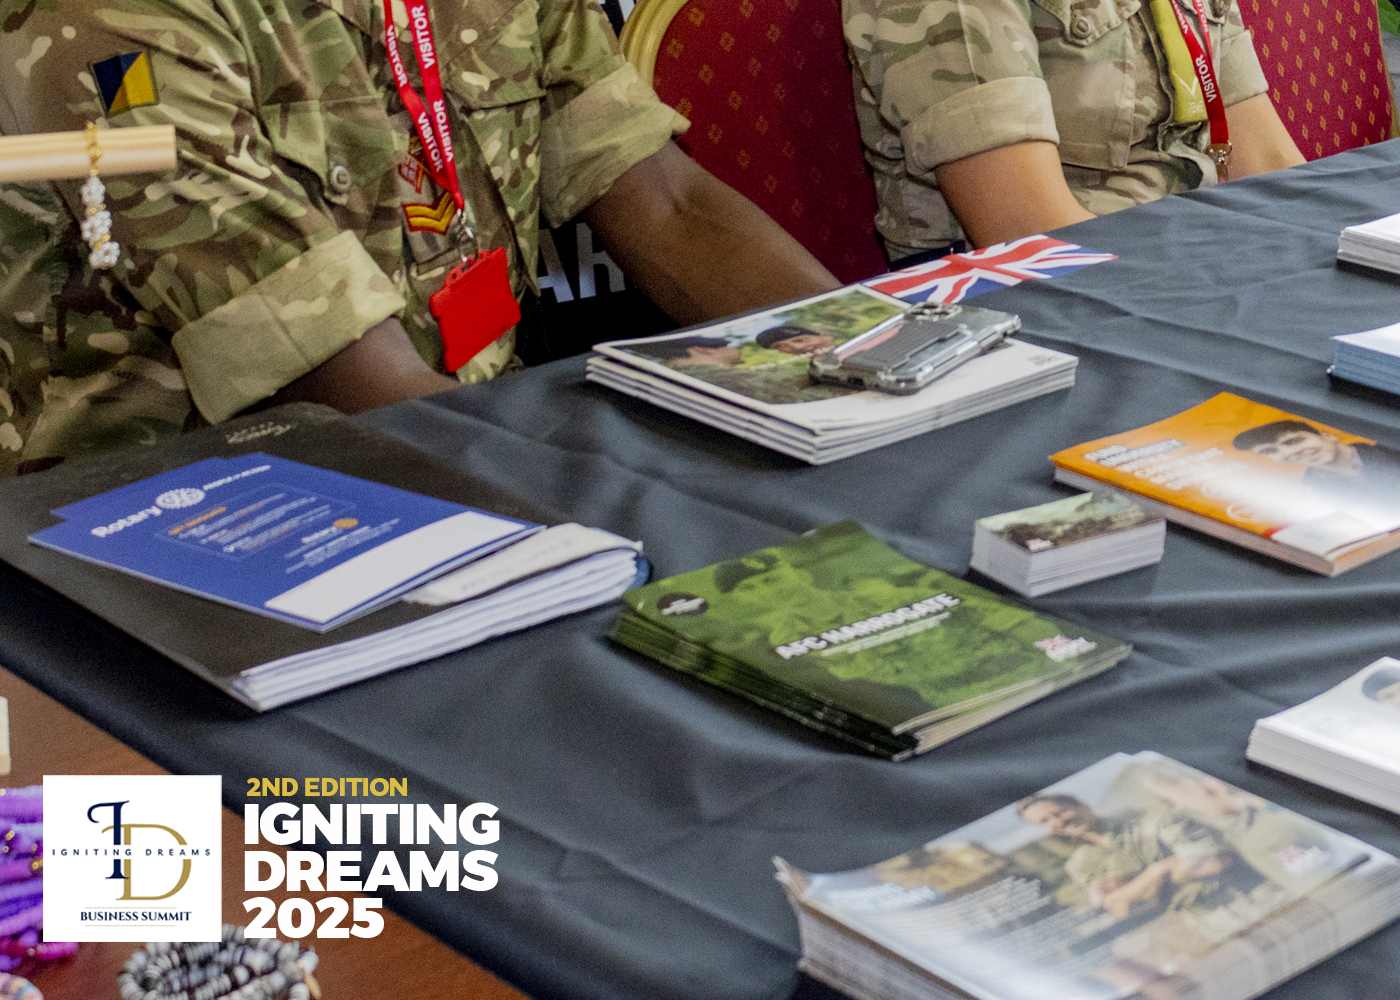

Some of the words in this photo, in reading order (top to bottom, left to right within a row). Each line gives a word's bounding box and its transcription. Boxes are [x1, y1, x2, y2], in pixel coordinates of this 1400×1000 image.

[386, 24, 408, 88] VISITOR
[411, 4, 436, 69] VISITOR
[1195, 54, 1218, 103] VISITOR
[417, 111, 445, 173] VISITOR
[433, 99, 454, 163] VISITOR
[90, 505, 163, 538] Rotary
[775, 636, 828, 660] AFC
[820, 592, 960, 645] HARROGATE
